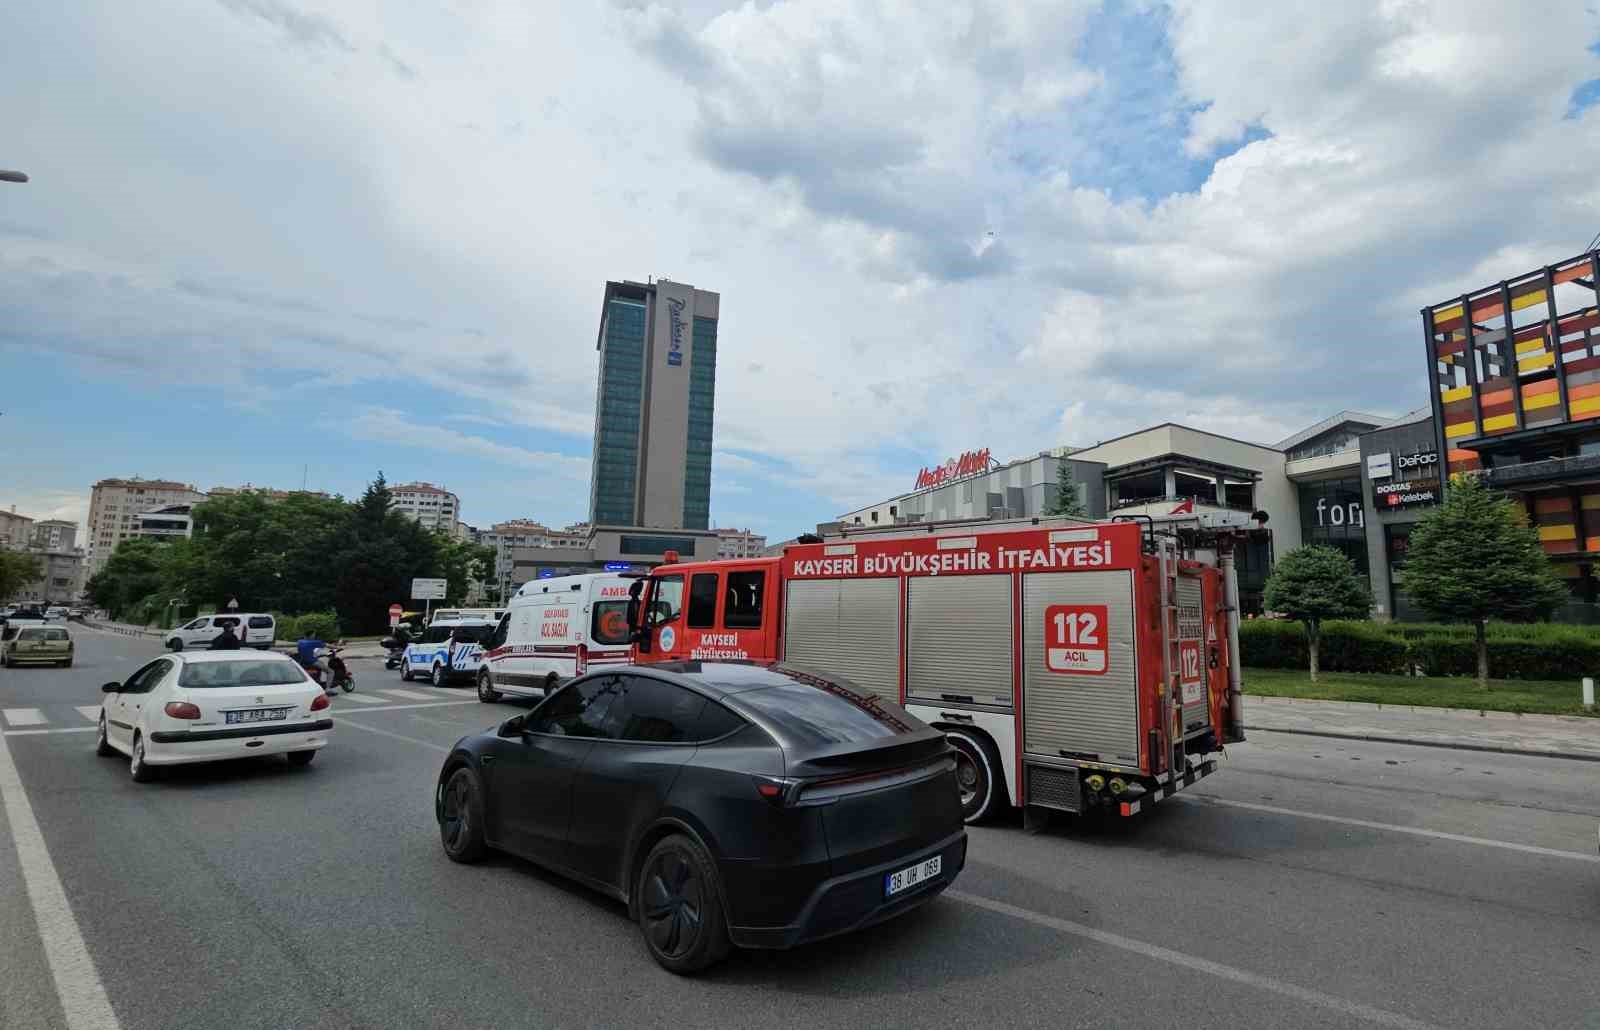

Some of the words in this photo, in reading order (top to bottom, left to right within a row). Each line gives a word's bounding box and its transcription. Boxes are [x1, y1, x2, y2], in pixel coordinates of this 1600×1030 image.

[1399, 454, 1437, 468] DeFac
[793, 555, 859, 576] KAYSERİ
[863, 549, 991, 575] BÜYÜKŞEHİR
[997, 540, 1112, 569] İTFAİYESİ
[701, 632, 738, 647] KAYSERİ
[1054, 612, 1098, 645] 112
[1182, 648, 1199, 679] 112
[891, 874, 902, 892] 38
[907, 867, 918, 885] UH
